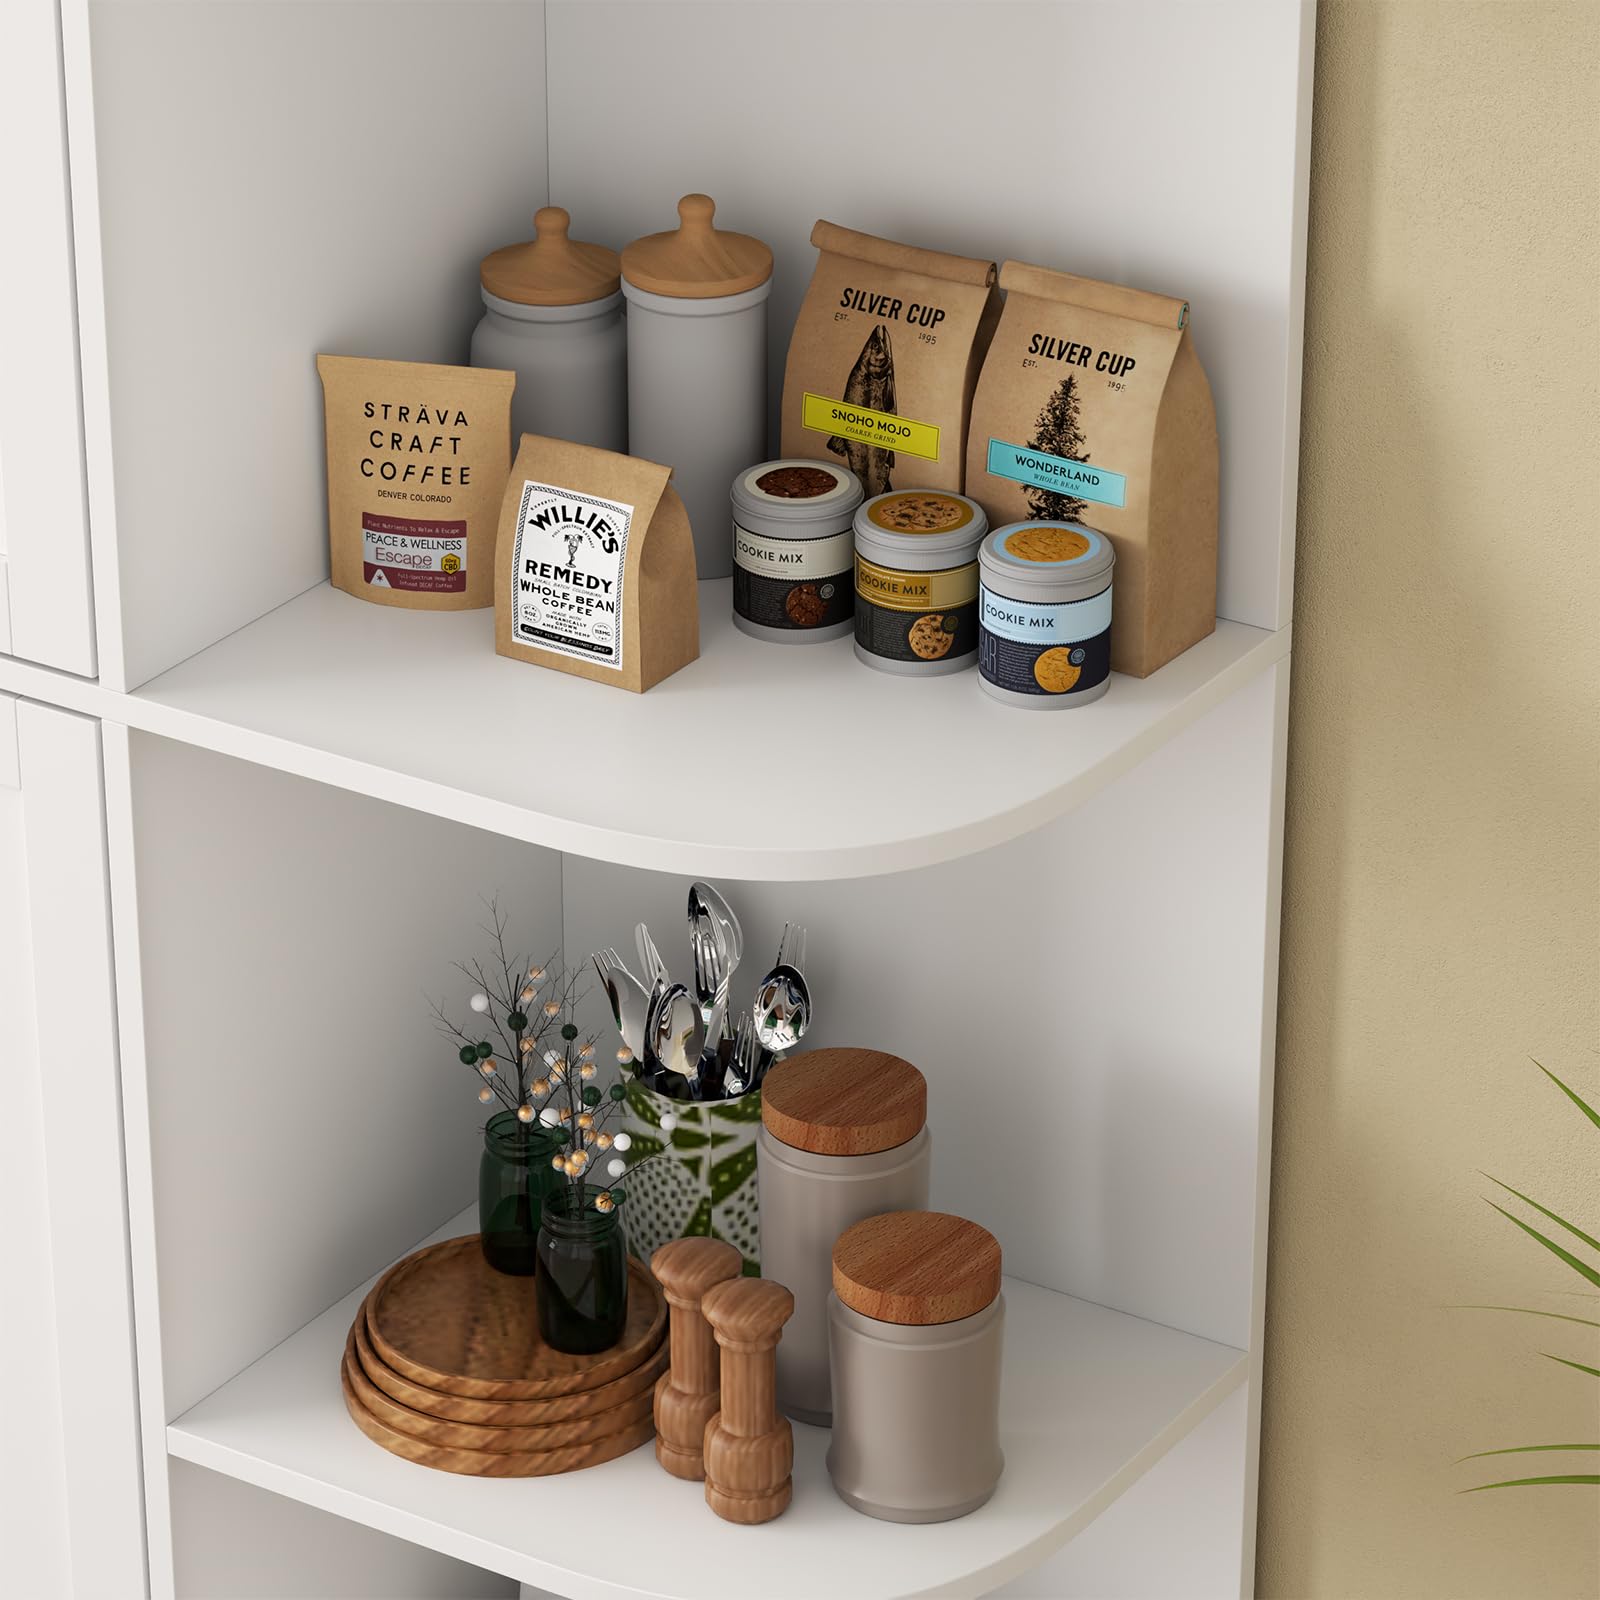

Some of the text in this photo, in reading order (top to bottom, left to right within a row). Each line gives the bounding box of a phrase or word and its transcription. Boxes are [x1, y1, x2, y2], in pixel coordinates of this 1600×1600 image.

[840, 287, 946, 329] SILVER CUP
[918, 332, 937, 345] 1995
[1028, 333, 1136, 377] SILVER CUP
[1107, 381, 1126, 393] 1995
[364, 402, 468, 426] STRÄVA
[832, 409, 911, 438] SNOHO MOJO
[370, 430, 461, 455] CRAFT
[845, 426, 896, 444] COARSE GRIND
[360, 458, 471, 485] COFFEE
[1015, 454, 1100, 486] WONDERLAND
[1033, 473, 1080, 491] WHOLE BEAN
[378, 489, 452, 503] DENVER COLORADO
[382, 523, 408, 532] Nutrients
[528, 505, 619, 554] WILLIE'S
[365, 531, 462, 551] PEACE & WELLNESS
[737, 540, 775, 561] COOKIE
[779, 553, 803, 563] MIX
[375, 547, 432, 568] Escape
[444, 563, 458, 571] CBD
[525, 559, 613, 594] REMEDY
[860, 571, 899, 593] COOKIE
[902, 585, 927, 595] MIX
[520, 578, 615, 614] WHOLE BEAN
[542, 597, 593, 617] COFFEE
[545, 613, 587, 628] ORGANICALLY
[555, 621, 578, 631] GROWN
[985, 603, 1025, 626] COOKIE
[1029, 618, 1055, 628] MIX
[542, 622, 591, 638] AMERICAN HEMP
